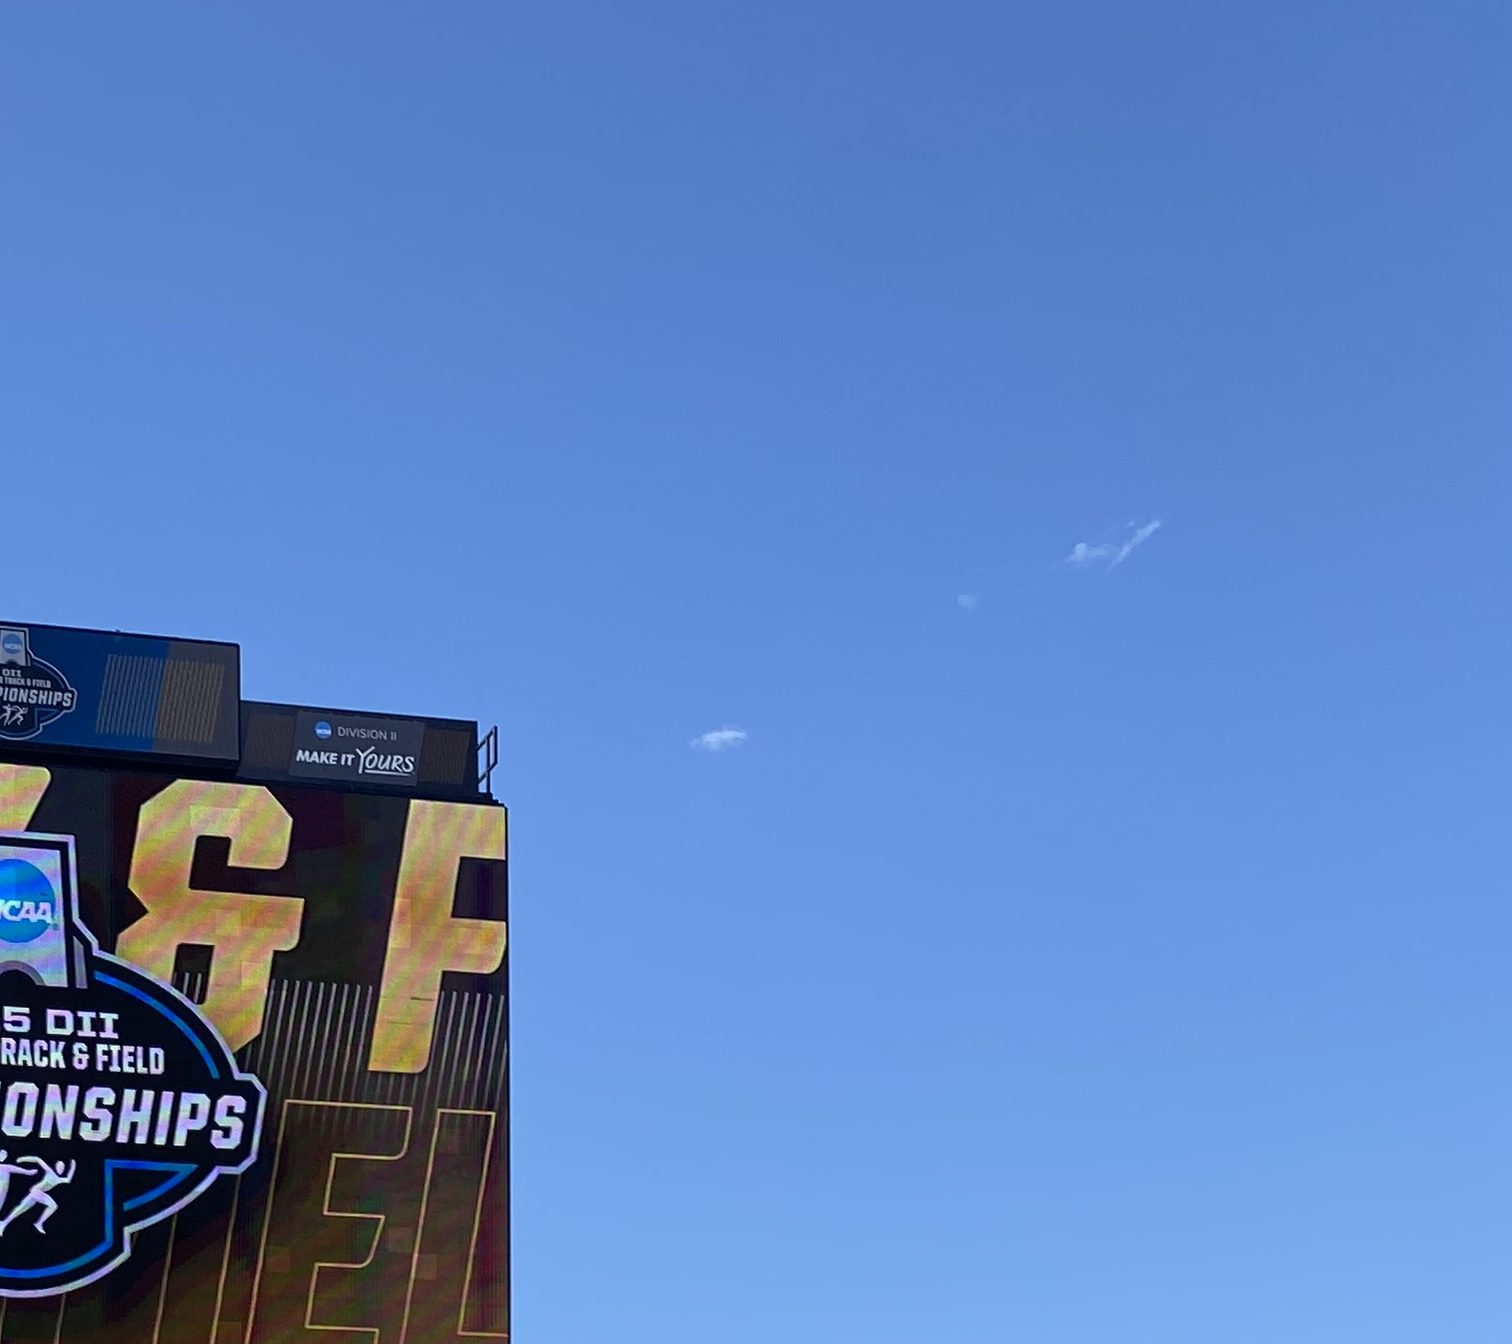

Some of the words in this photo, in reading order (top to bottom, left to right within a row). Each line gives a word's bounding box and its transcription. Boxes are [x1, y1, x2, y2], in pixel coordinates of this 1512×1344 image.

[337, 726, 387, 740] DIVISION
[296, 749, 338, 765] MAKE
[341, 753, 355, 766] IT
[116, 779, 305, 1053] &
[368, 799, 507, 1073] F
[45, 1008, 119, 1039] DII
[72, 1042, 90, 1070] &
[95, 1043, 165, 1075] FIELD
